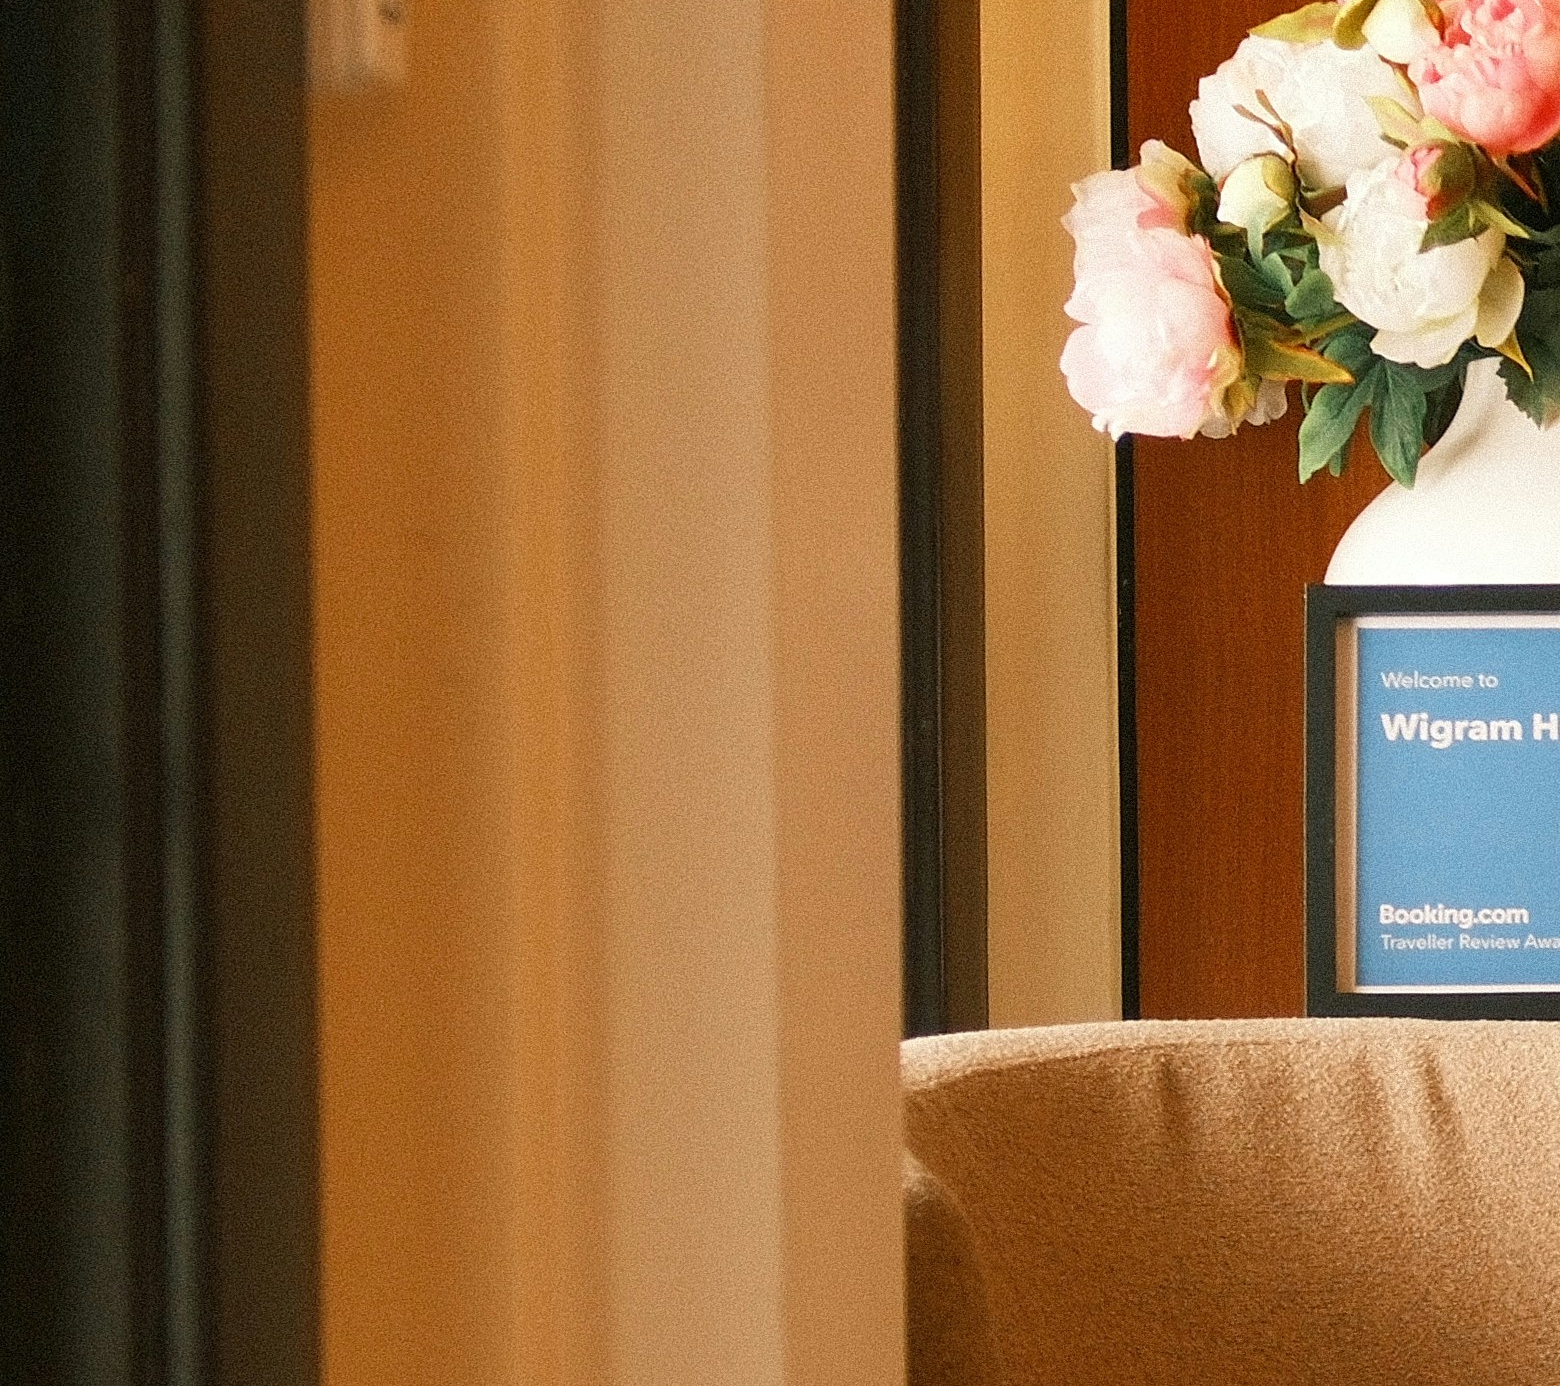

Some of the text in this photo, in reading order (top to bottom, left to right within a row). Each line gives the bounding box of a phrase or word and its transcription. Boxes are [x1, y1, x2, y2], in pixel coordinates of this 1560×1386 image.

[1381, 670, 1499, 690] Welcome to
[1381, 711, 1523, 750] Wigram
[1379, 903, 1529, 929] Booking.com
[1381, 933, 1455, 950] Traveller
[1458, 933, 1521, 950] Review
